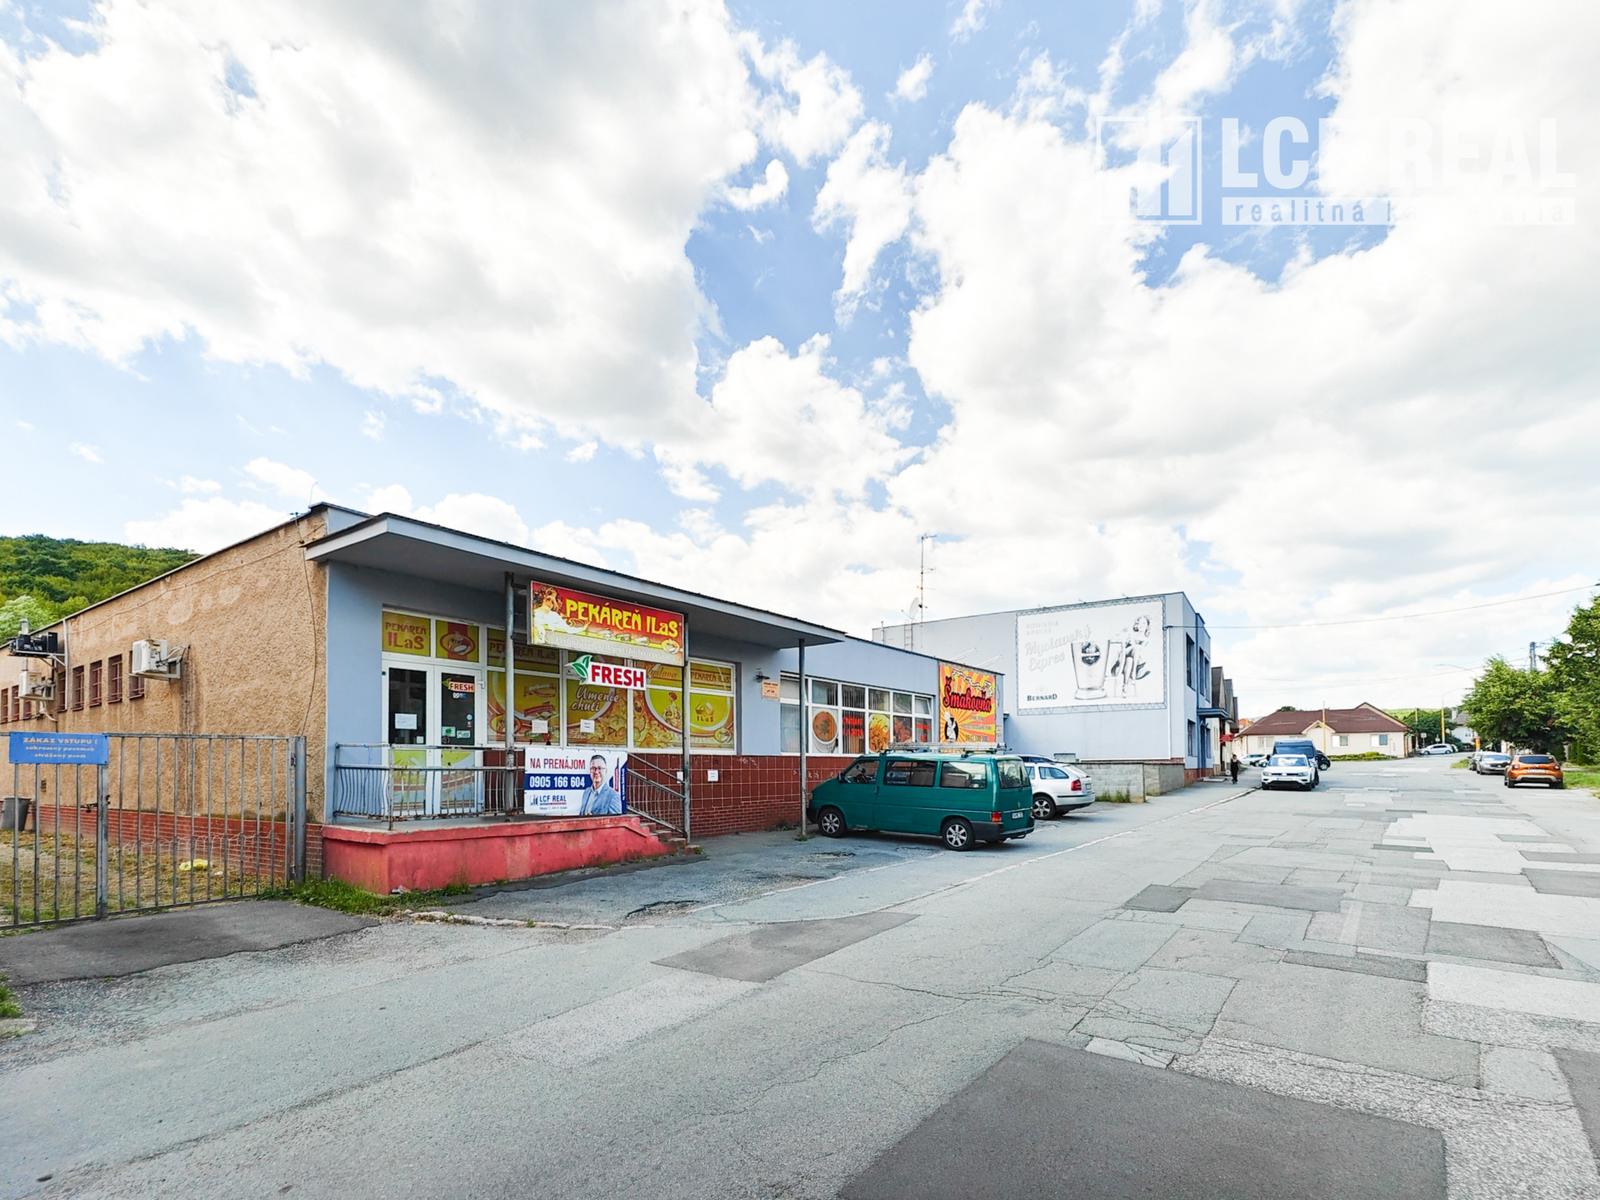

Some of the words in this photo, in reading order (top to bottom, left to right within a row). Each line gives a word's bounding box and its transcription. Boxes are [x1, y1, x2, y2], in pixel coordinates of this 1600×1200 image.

[565, 598, 641, 631] PEKÁREŇ
[591, 664, 645, 688] FRESH
[450, 682, 474, 691] FRESH
[529, 758, 541, 769] NA
[543, 756, 586, 770] PRENÁJOM
[529, 775, 551, 788] 0905
[553, 776, 568, 788] 166
[570, 776, 586, 788] 604
[552, 794, 567, 802] REAL
